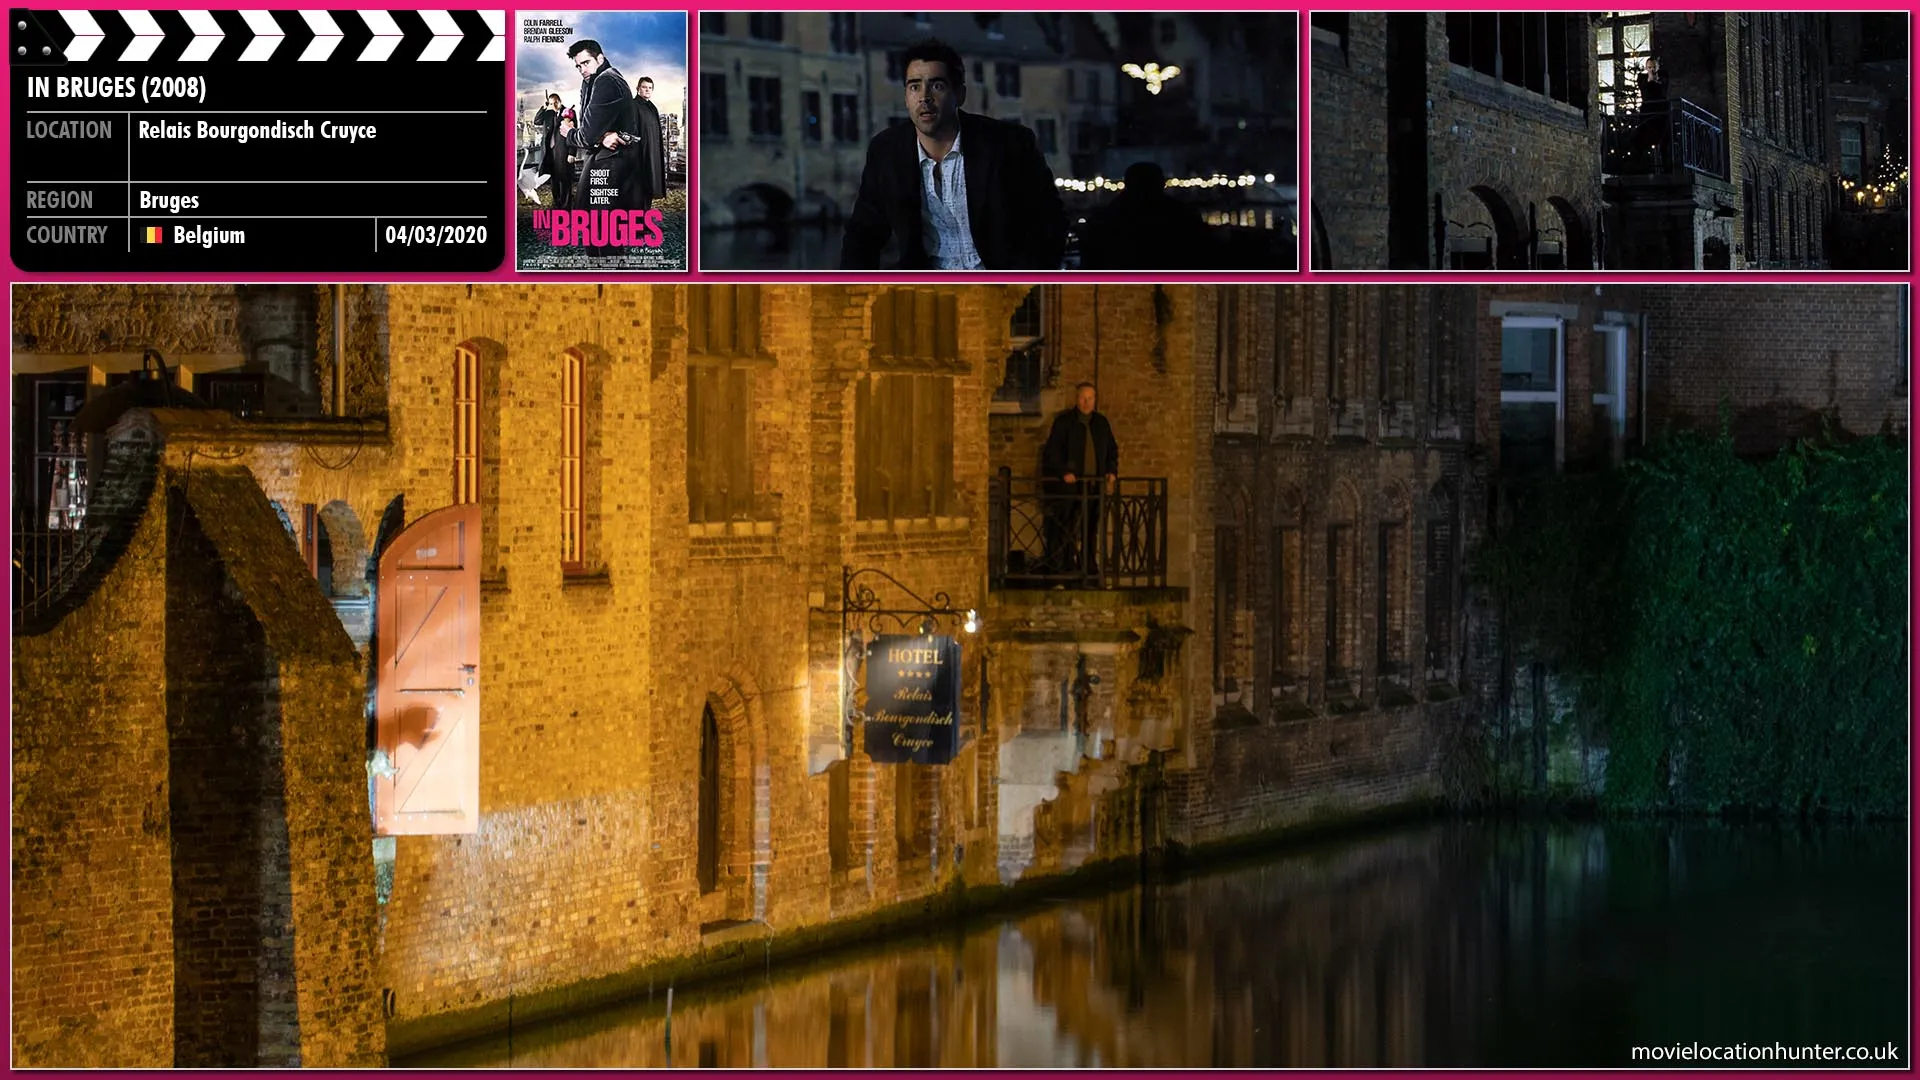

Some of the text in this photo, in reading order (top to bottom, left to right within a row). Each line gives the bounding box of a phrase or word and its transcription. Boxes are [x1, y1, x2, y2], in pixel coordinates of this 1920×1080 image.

[590, 169, 610, 177] SHOOT
[590, 177, 608, 185] FIRST.
[590, 197, 610, 205] LATER.
[533, 209, 663, 247] IN BRUGES
[888, 648, 943, 665] HOTEL
[893, 687, 933, 701] Relais
[871, 709, 953, 729] Bourgondisch
[892, 732, 934, 752] Cruyce
